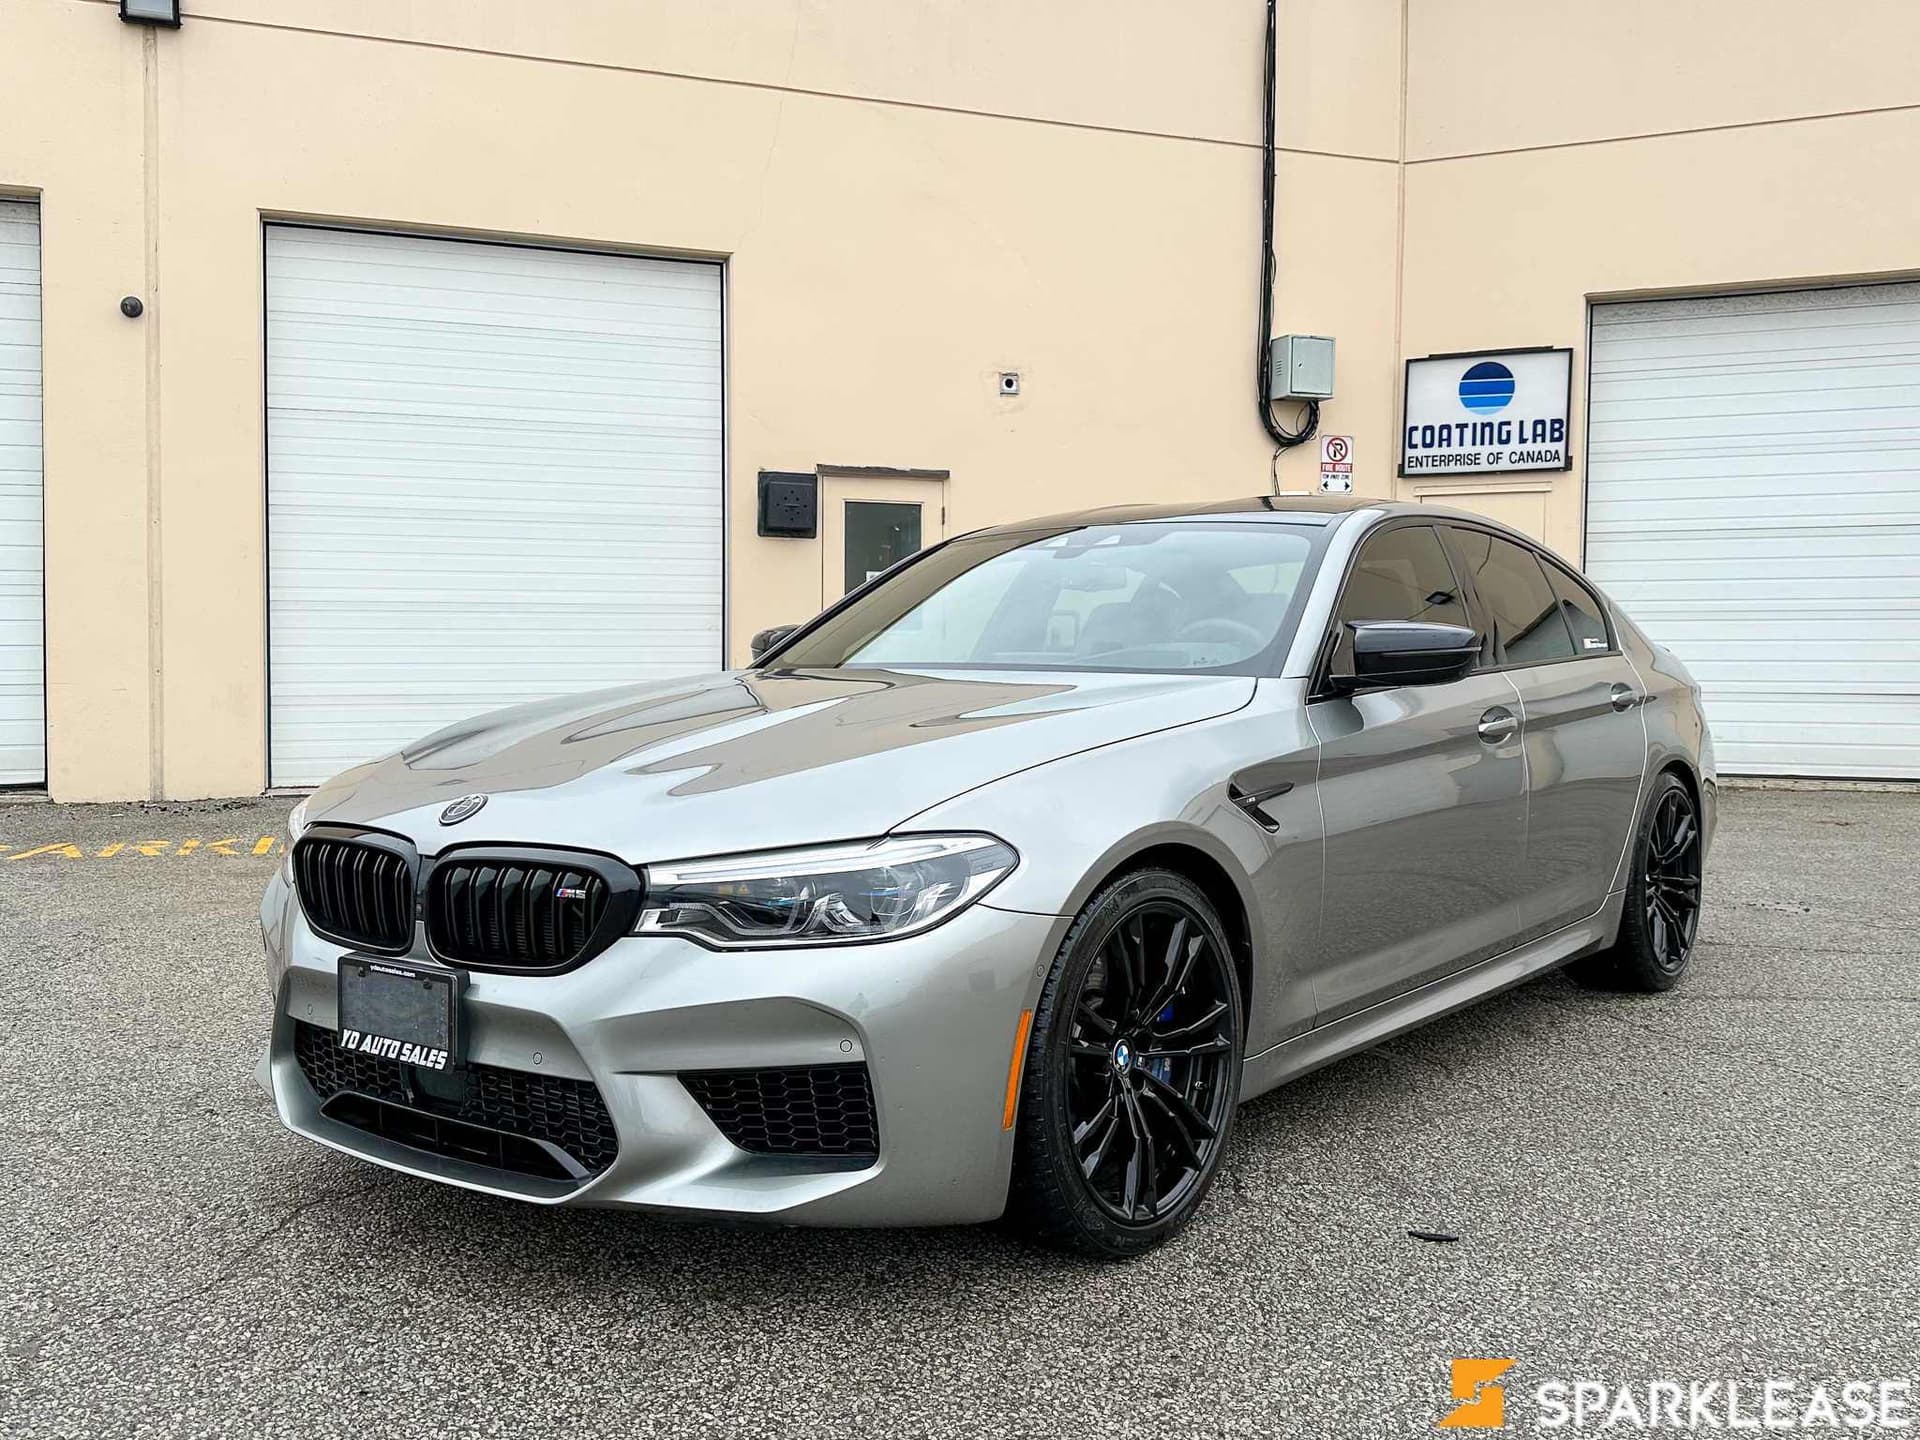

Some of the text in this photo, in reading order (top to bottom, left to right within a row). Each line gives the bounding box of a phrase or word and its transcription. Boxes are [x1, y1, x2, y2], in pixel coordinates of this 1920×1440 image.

[1407, 417, 1565, 450] COATING LAB
[1407, 449, 1561, 469] ENTERPRISE OF CANADA
[359, 1034, 401, 1060] AUTO
[399, 1042, 448, 1071] SALES
